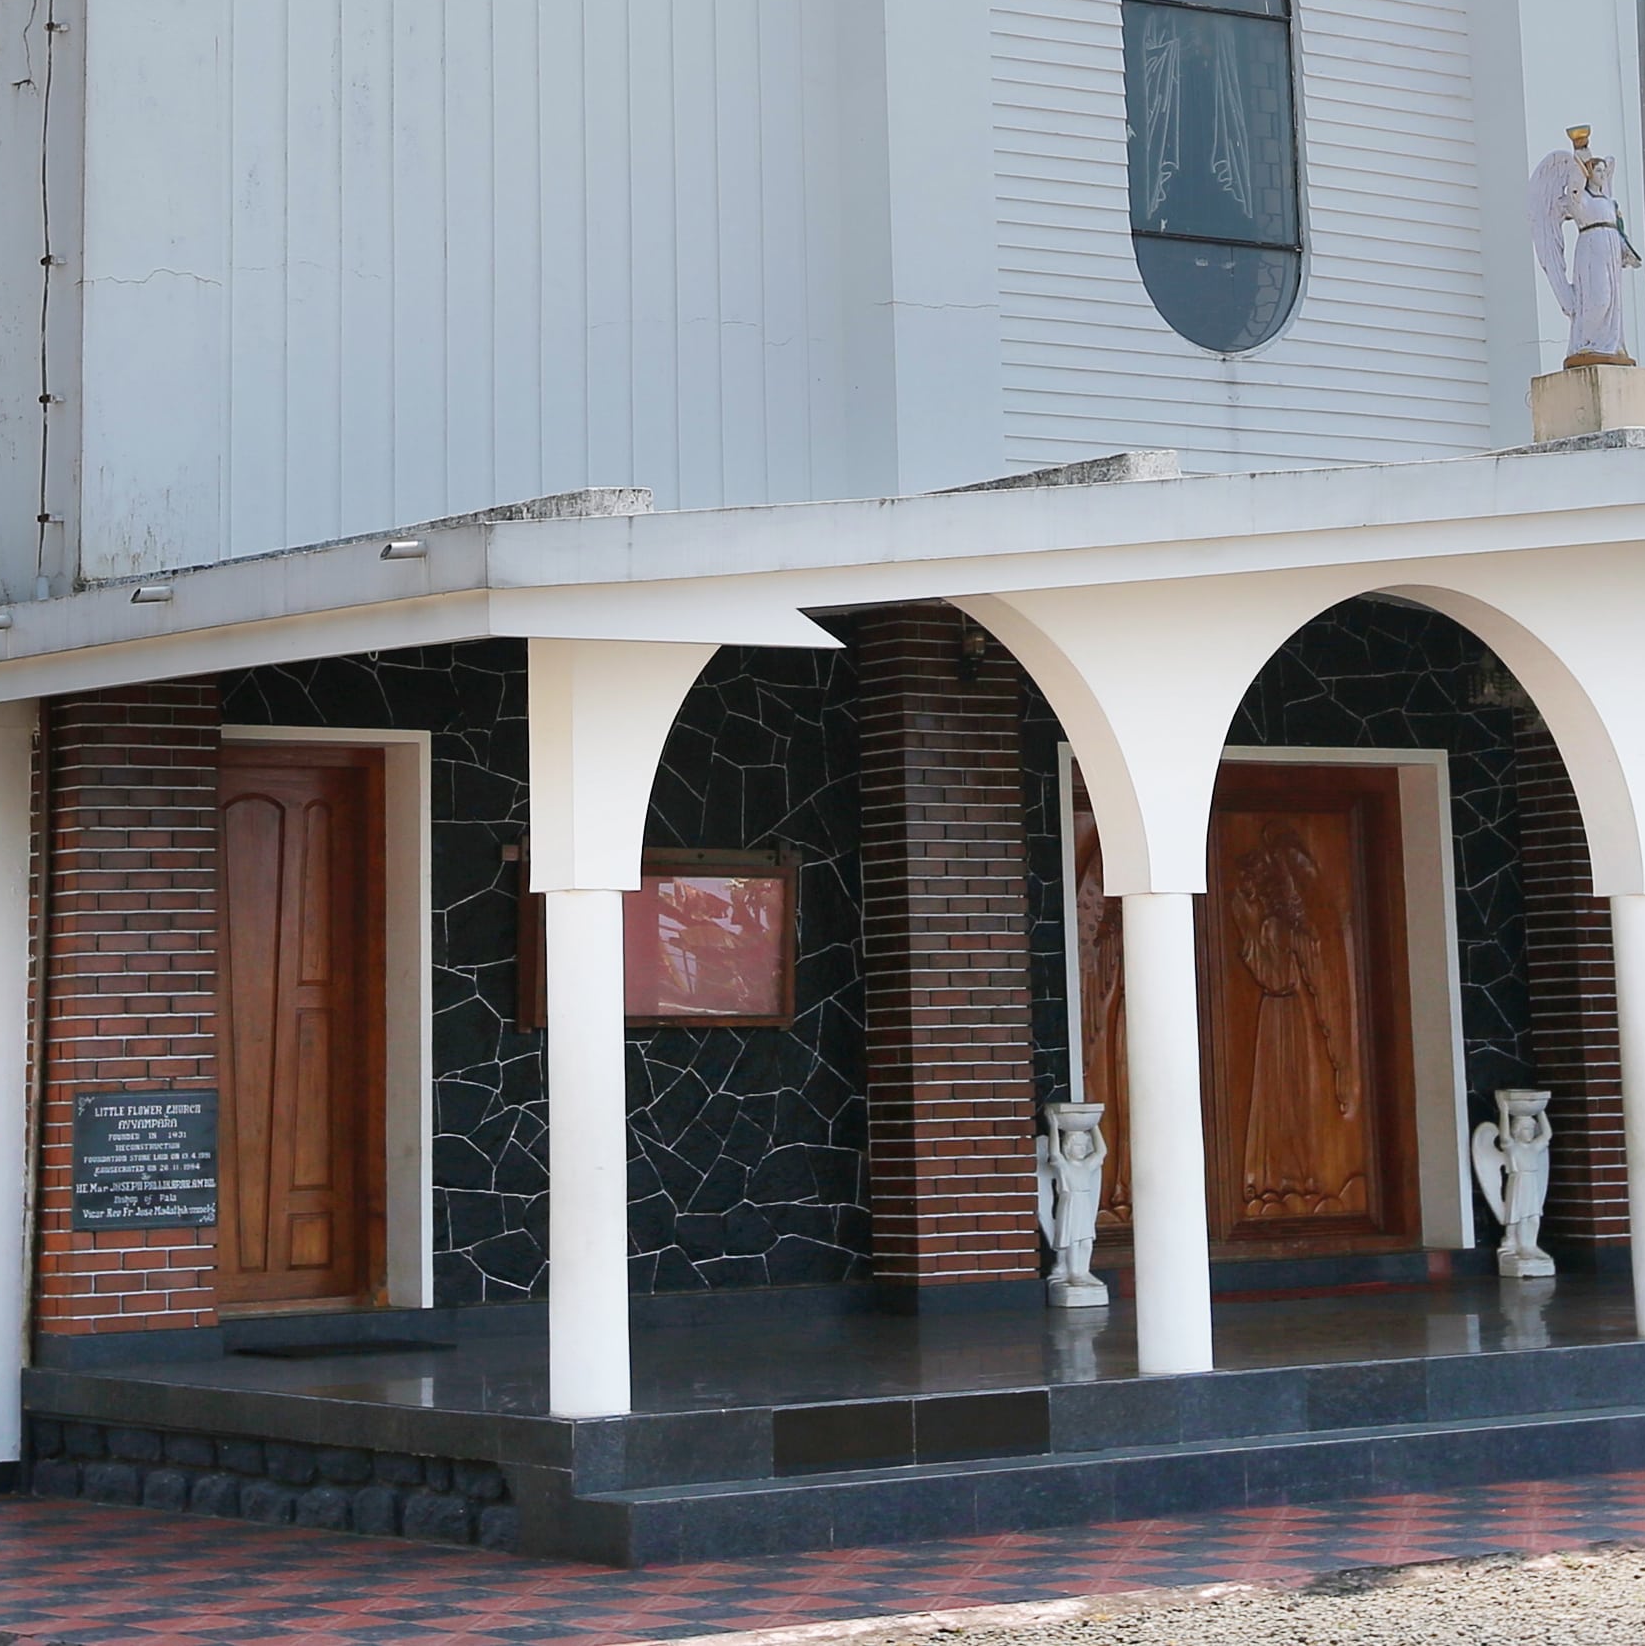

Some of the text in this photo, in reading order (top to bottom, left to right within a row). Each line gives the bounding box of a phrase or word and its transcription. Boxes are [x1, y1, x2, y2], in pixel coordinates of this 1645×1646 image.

[95, 1104, 201, 1117] LITTLE FLOWER CHURCH
